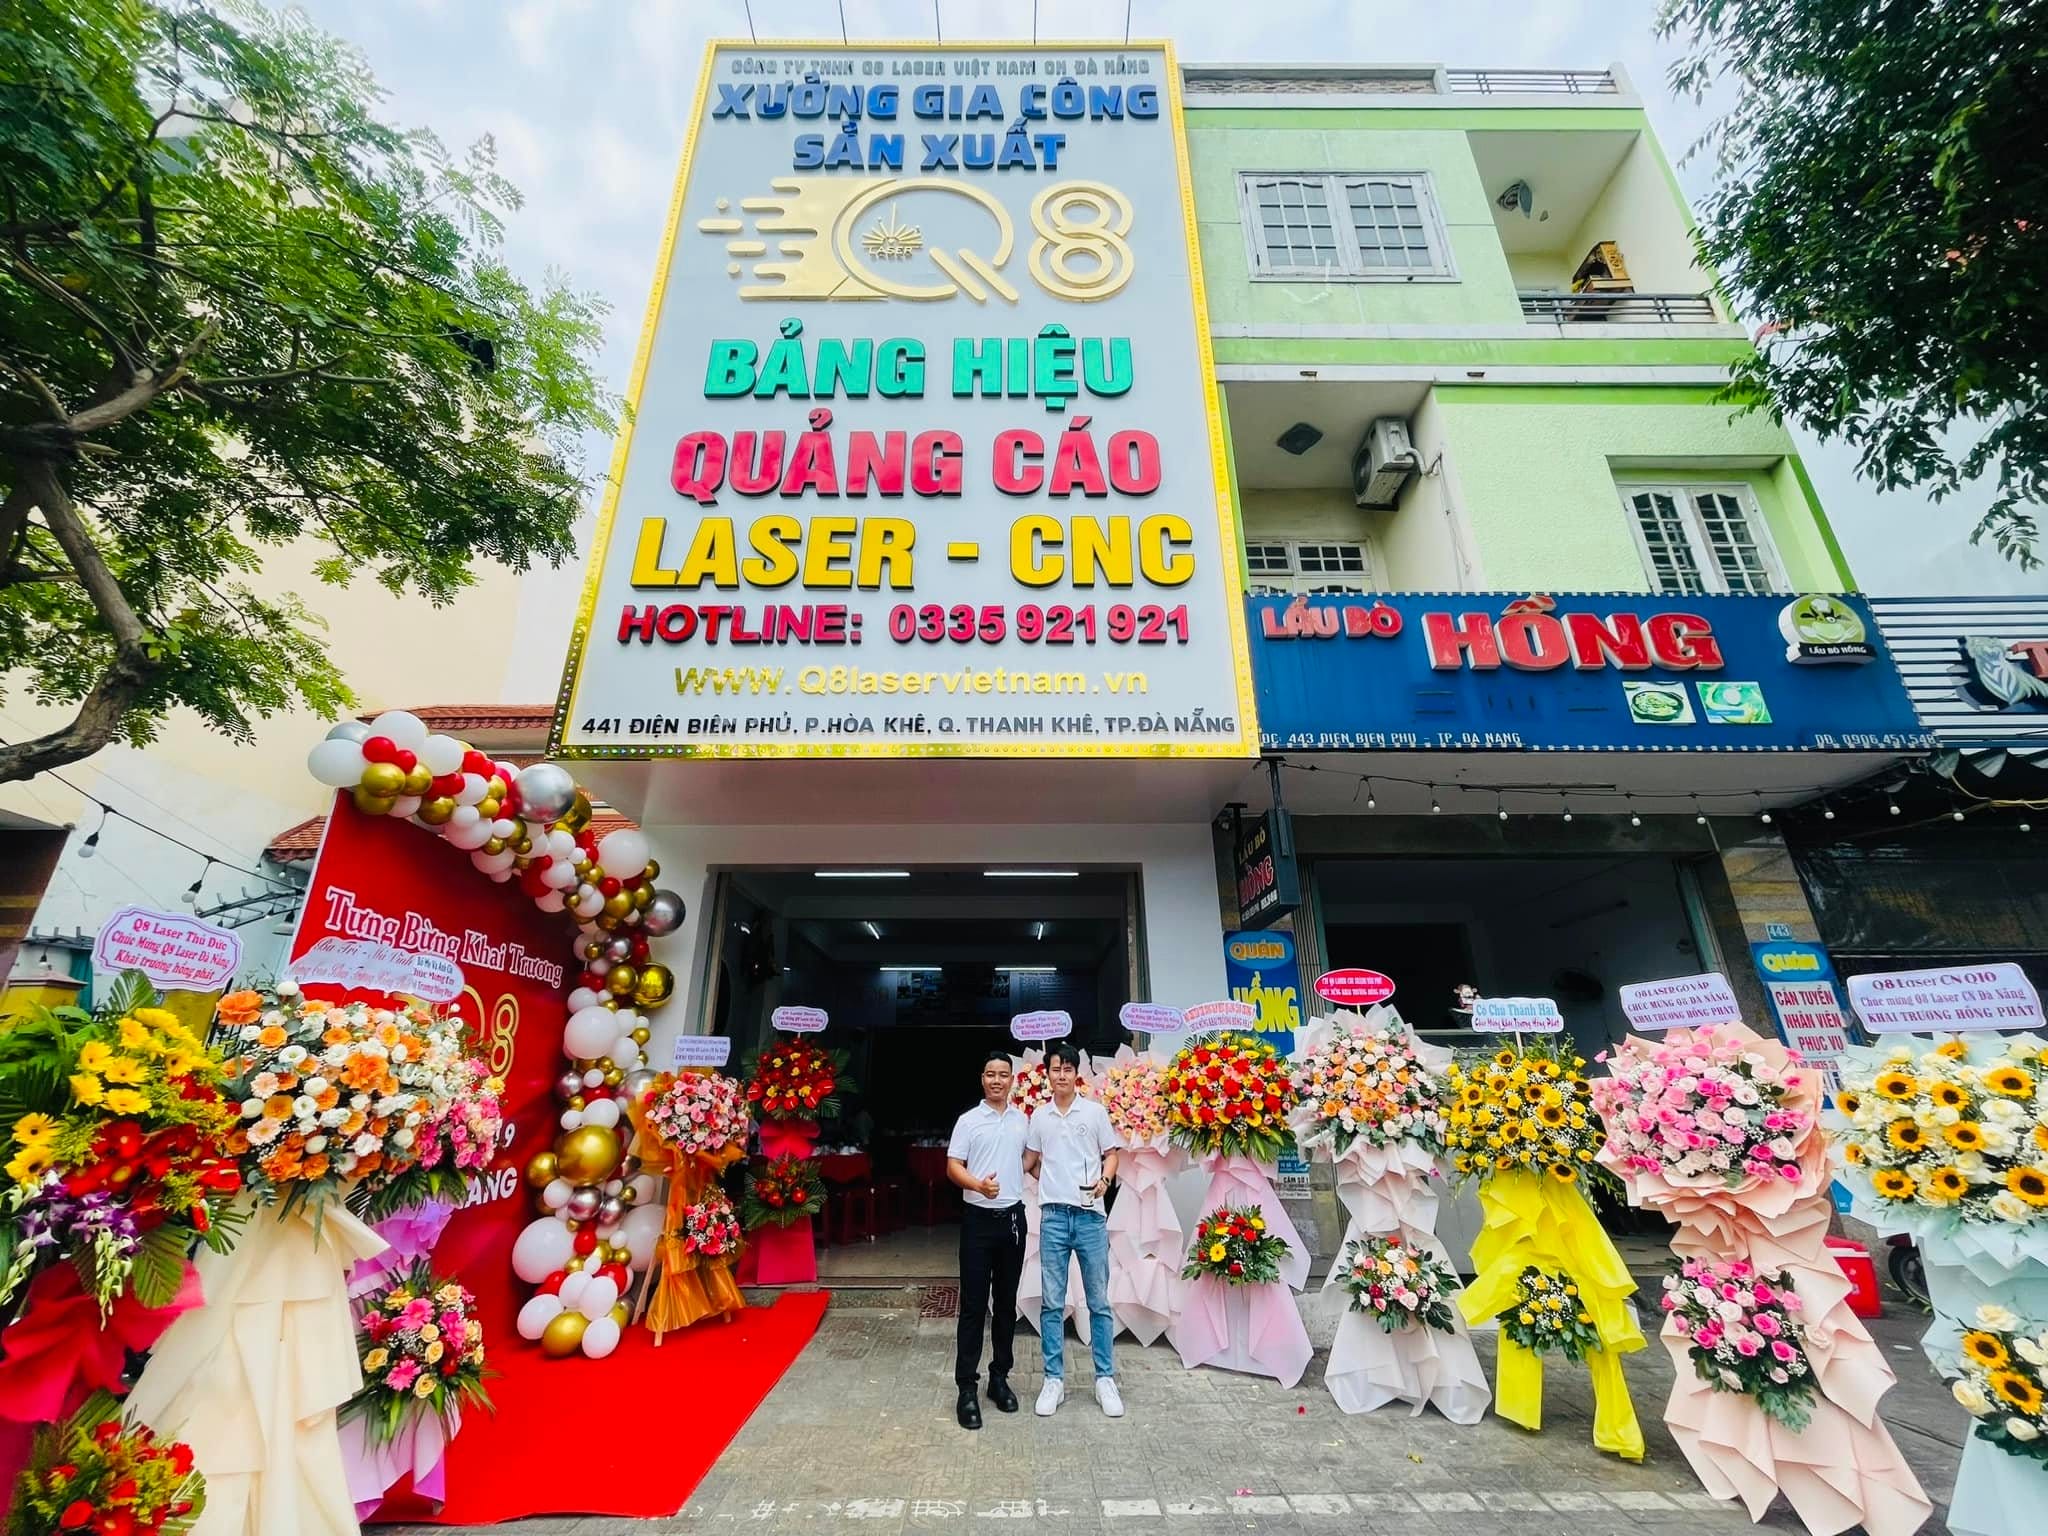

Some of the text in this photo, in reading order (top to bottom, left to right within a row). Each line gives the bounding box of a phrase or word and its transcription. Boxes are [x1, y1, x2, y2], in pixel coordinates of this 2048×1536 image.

[712, 71, 1159, 121] XƯỞNG GIA CÔNG
[793, 117, 1066, 170] SẢN XUẤT
[868, 246, 914, 258] LASER
[704, 317, 1135, 411] BẢNG HIỆU
[670, 408, 1163, 505] QUẢNG CÁO
[630, 513, 1196, 592] LASER - CNC
[616, 604, 1190, 645] HOTLINE: 0335 921 921
[1261, 593, 1725, 672] LẨU BÒ HỒNG
[582, 718, 622, 734] 441
[629, 714, 680, 738] ĐIỆN
[688, 714, 737, 735] BIÊN
[937, 716, 961, 735] Q.
[966, 716, 1044, 734] THANH
[1174, 707, 1236, 733] NẴNG
[1288, 732, 1315, 744] 443
[133, 918, 228, 951] Q8 Laser Thủ Đức
[1769, 925, 1791, 937] 443
[1230, 939, 1285, 960] QUÁN
[1775, 985, 1835, 1006] CẦN TUYỂN
[1872, 971, 1997, 991] Q8 Laser CN Q10
[1784, 1010, 1842, 1029] NHÂN VIÊN
[1798, 1035, 1845, 1055] PHỤC VỤ
